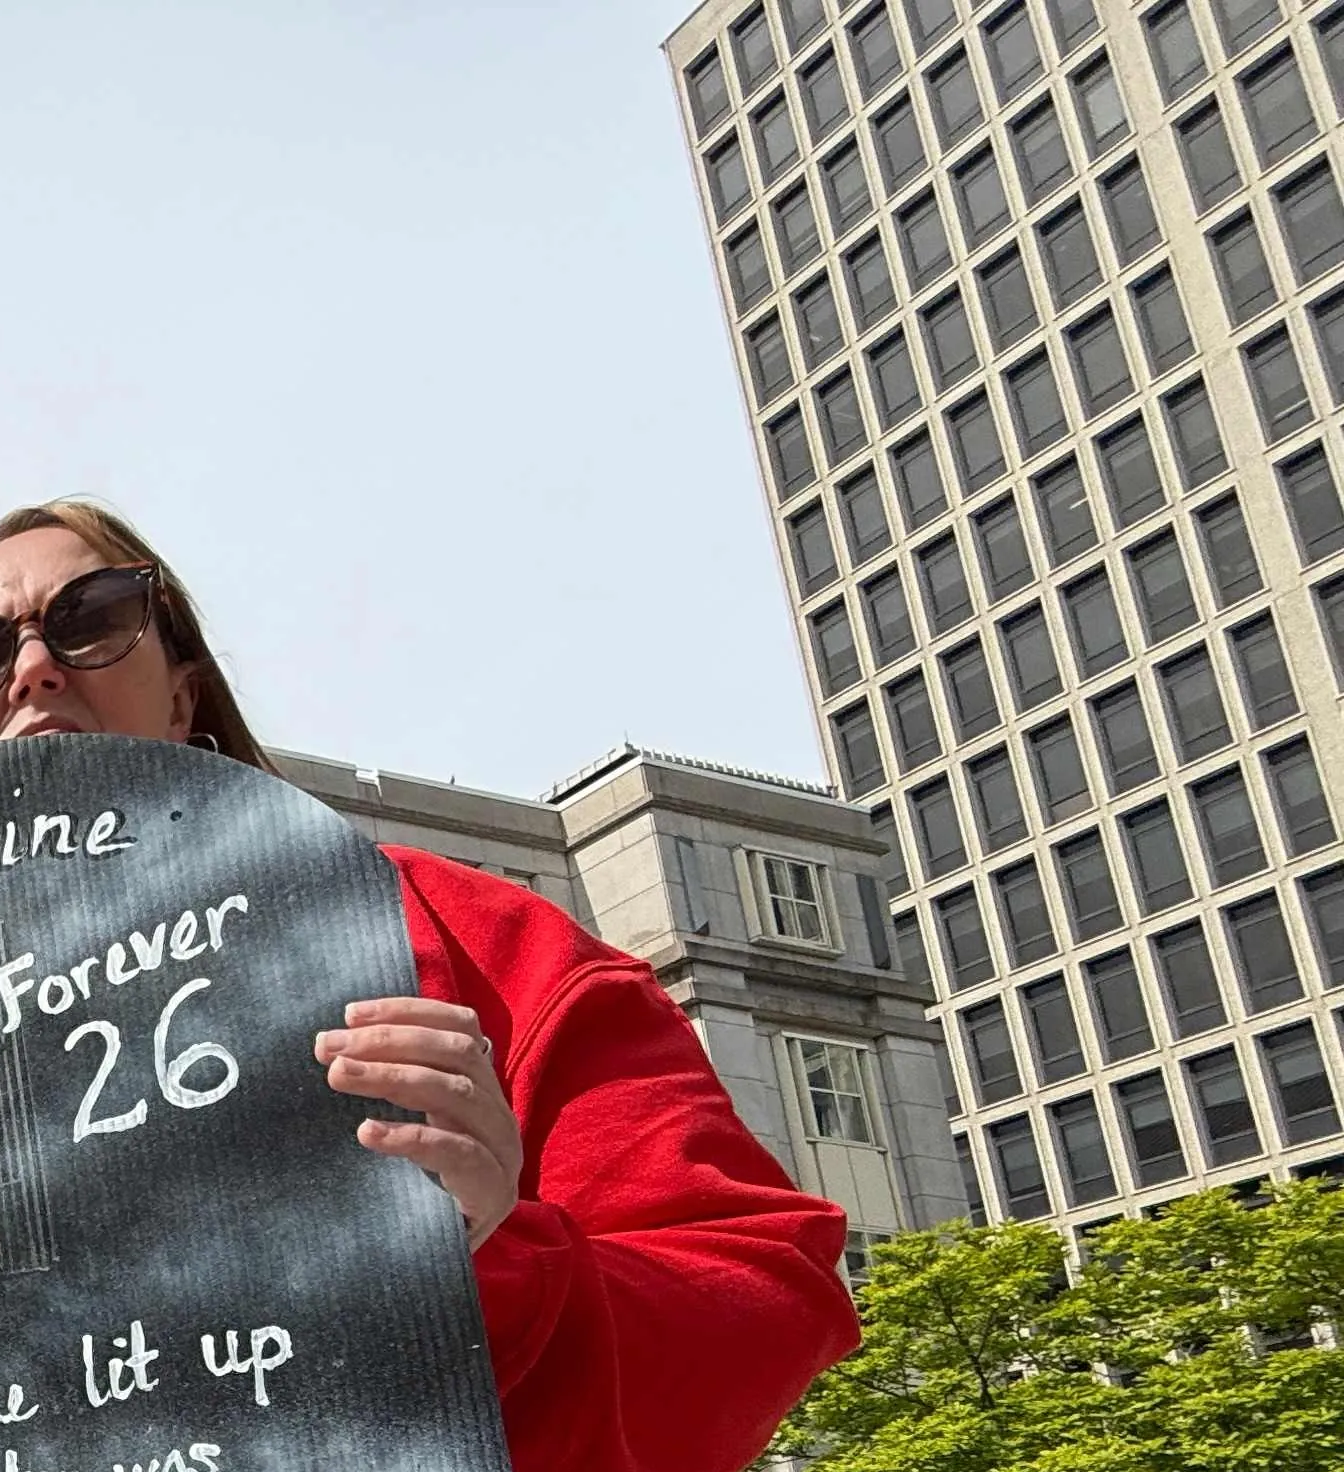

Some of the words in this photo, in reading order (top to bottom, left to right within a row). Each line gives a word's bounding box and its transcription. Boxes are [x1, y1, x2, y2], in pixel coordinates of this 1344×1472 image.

[65, 978, 239, 1144] 26
[81, 1320, 160, 1408] lit
[200, 1325, 294, 1407] up
